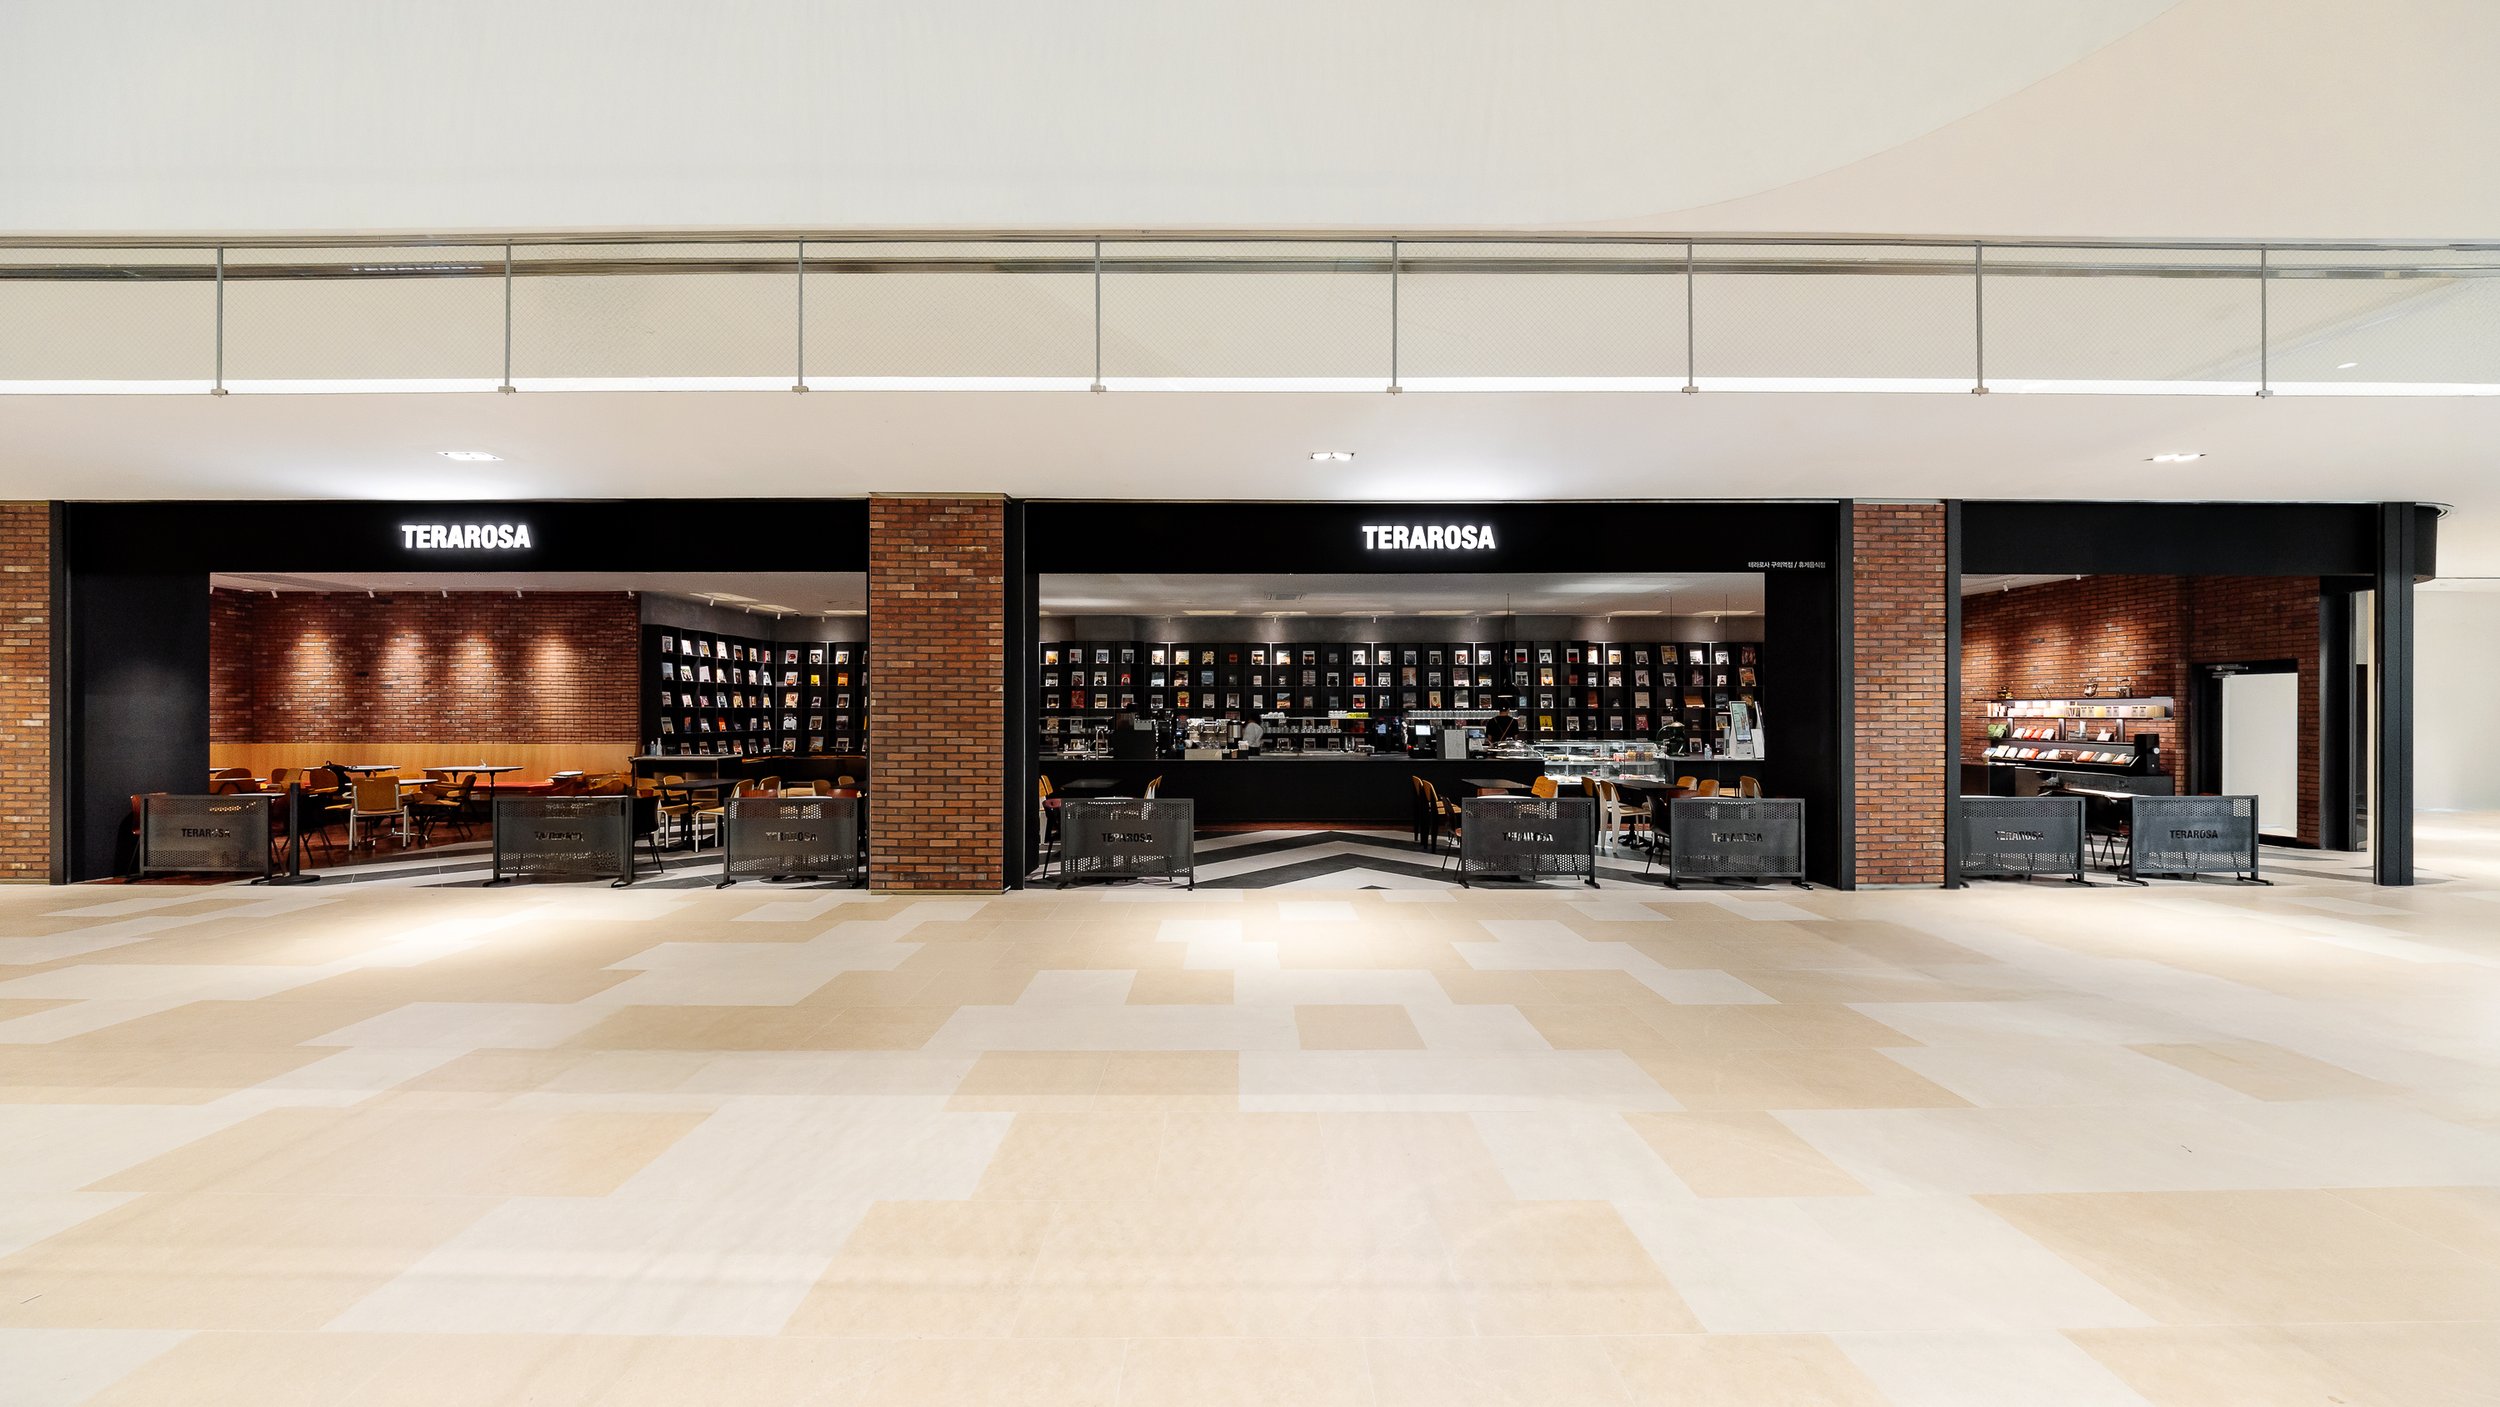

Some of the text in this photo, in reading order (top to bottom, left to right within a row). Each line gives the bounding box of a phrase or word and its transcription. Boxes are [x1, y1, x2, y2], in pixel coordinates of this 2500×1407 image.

[401, 524, 532, 549] TERAROSA
[1362, 525, 1496, 550] TERAROSA
[1747, 561, 1770, 569] 테라로사
[181, 828, 231, 838] TERAROSA
[2169, 829, 2219, 839] TERAROSA
